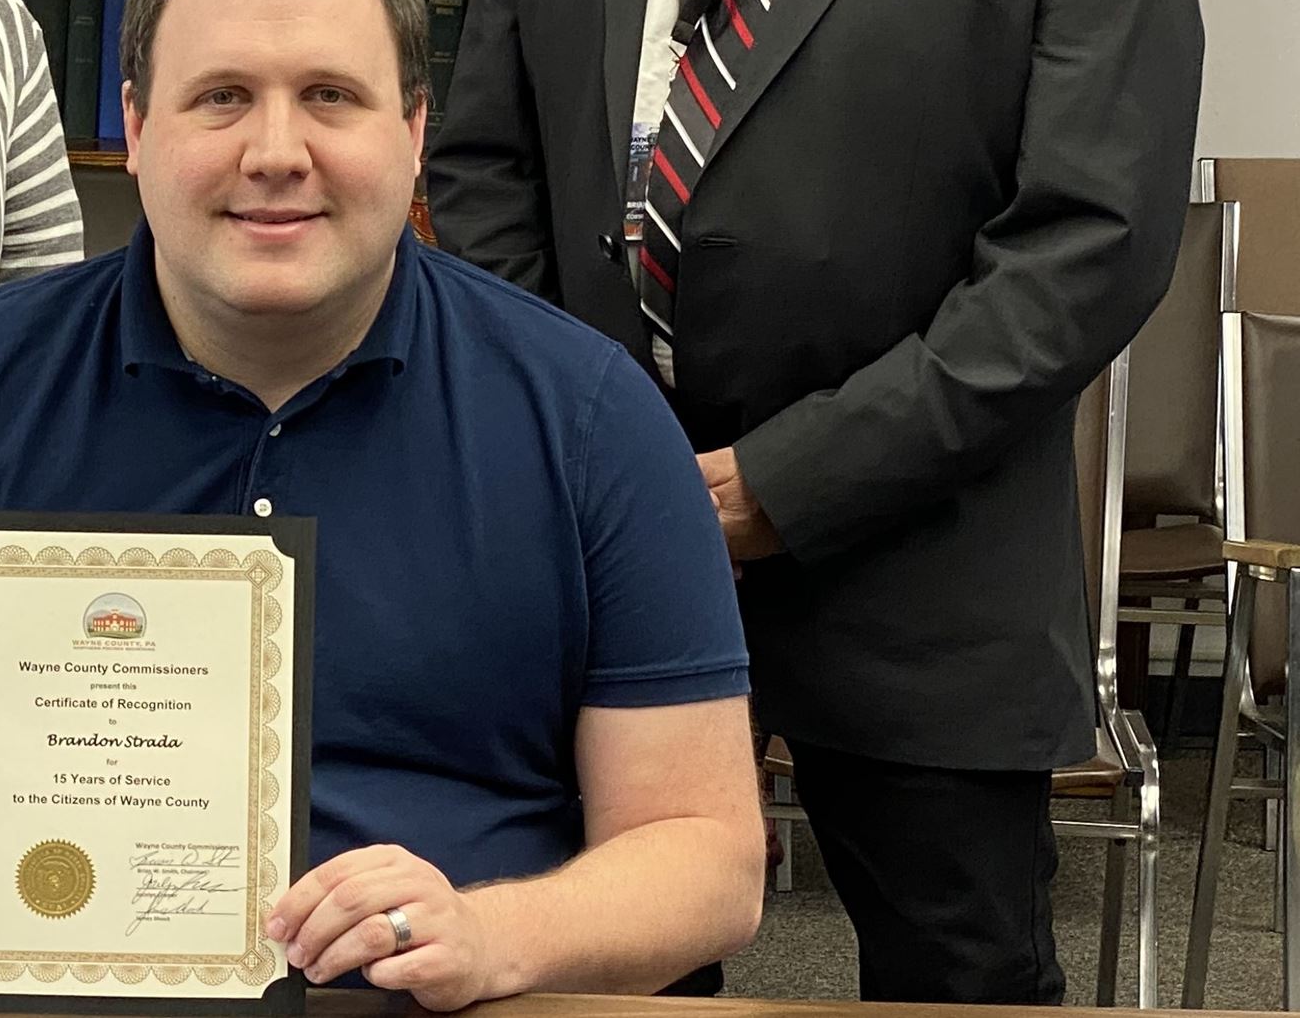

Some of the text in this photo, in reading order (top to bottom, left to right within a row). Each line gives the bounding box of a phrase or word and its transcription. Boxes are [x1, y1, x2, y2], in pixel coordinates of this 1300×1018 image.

[72, 639, 102, 647] WAYNE
[104, 640, 142, 648] COUNTY,
[19, 661, 209, 676] Wayne County Commissioners
[90, 682, 121, 691] present
[34, 697, 191, 711] Certificate of Recognition
[47, 733, 182, 749] Brandon Strada
[106, 758, 118, 766] for
[54, 774, 171, 786] 15 Years of Service
[12, 794, 209, 809] to the Citizens of Wayne County
[136, 842, 239, 851] Wayne County Commissioners
